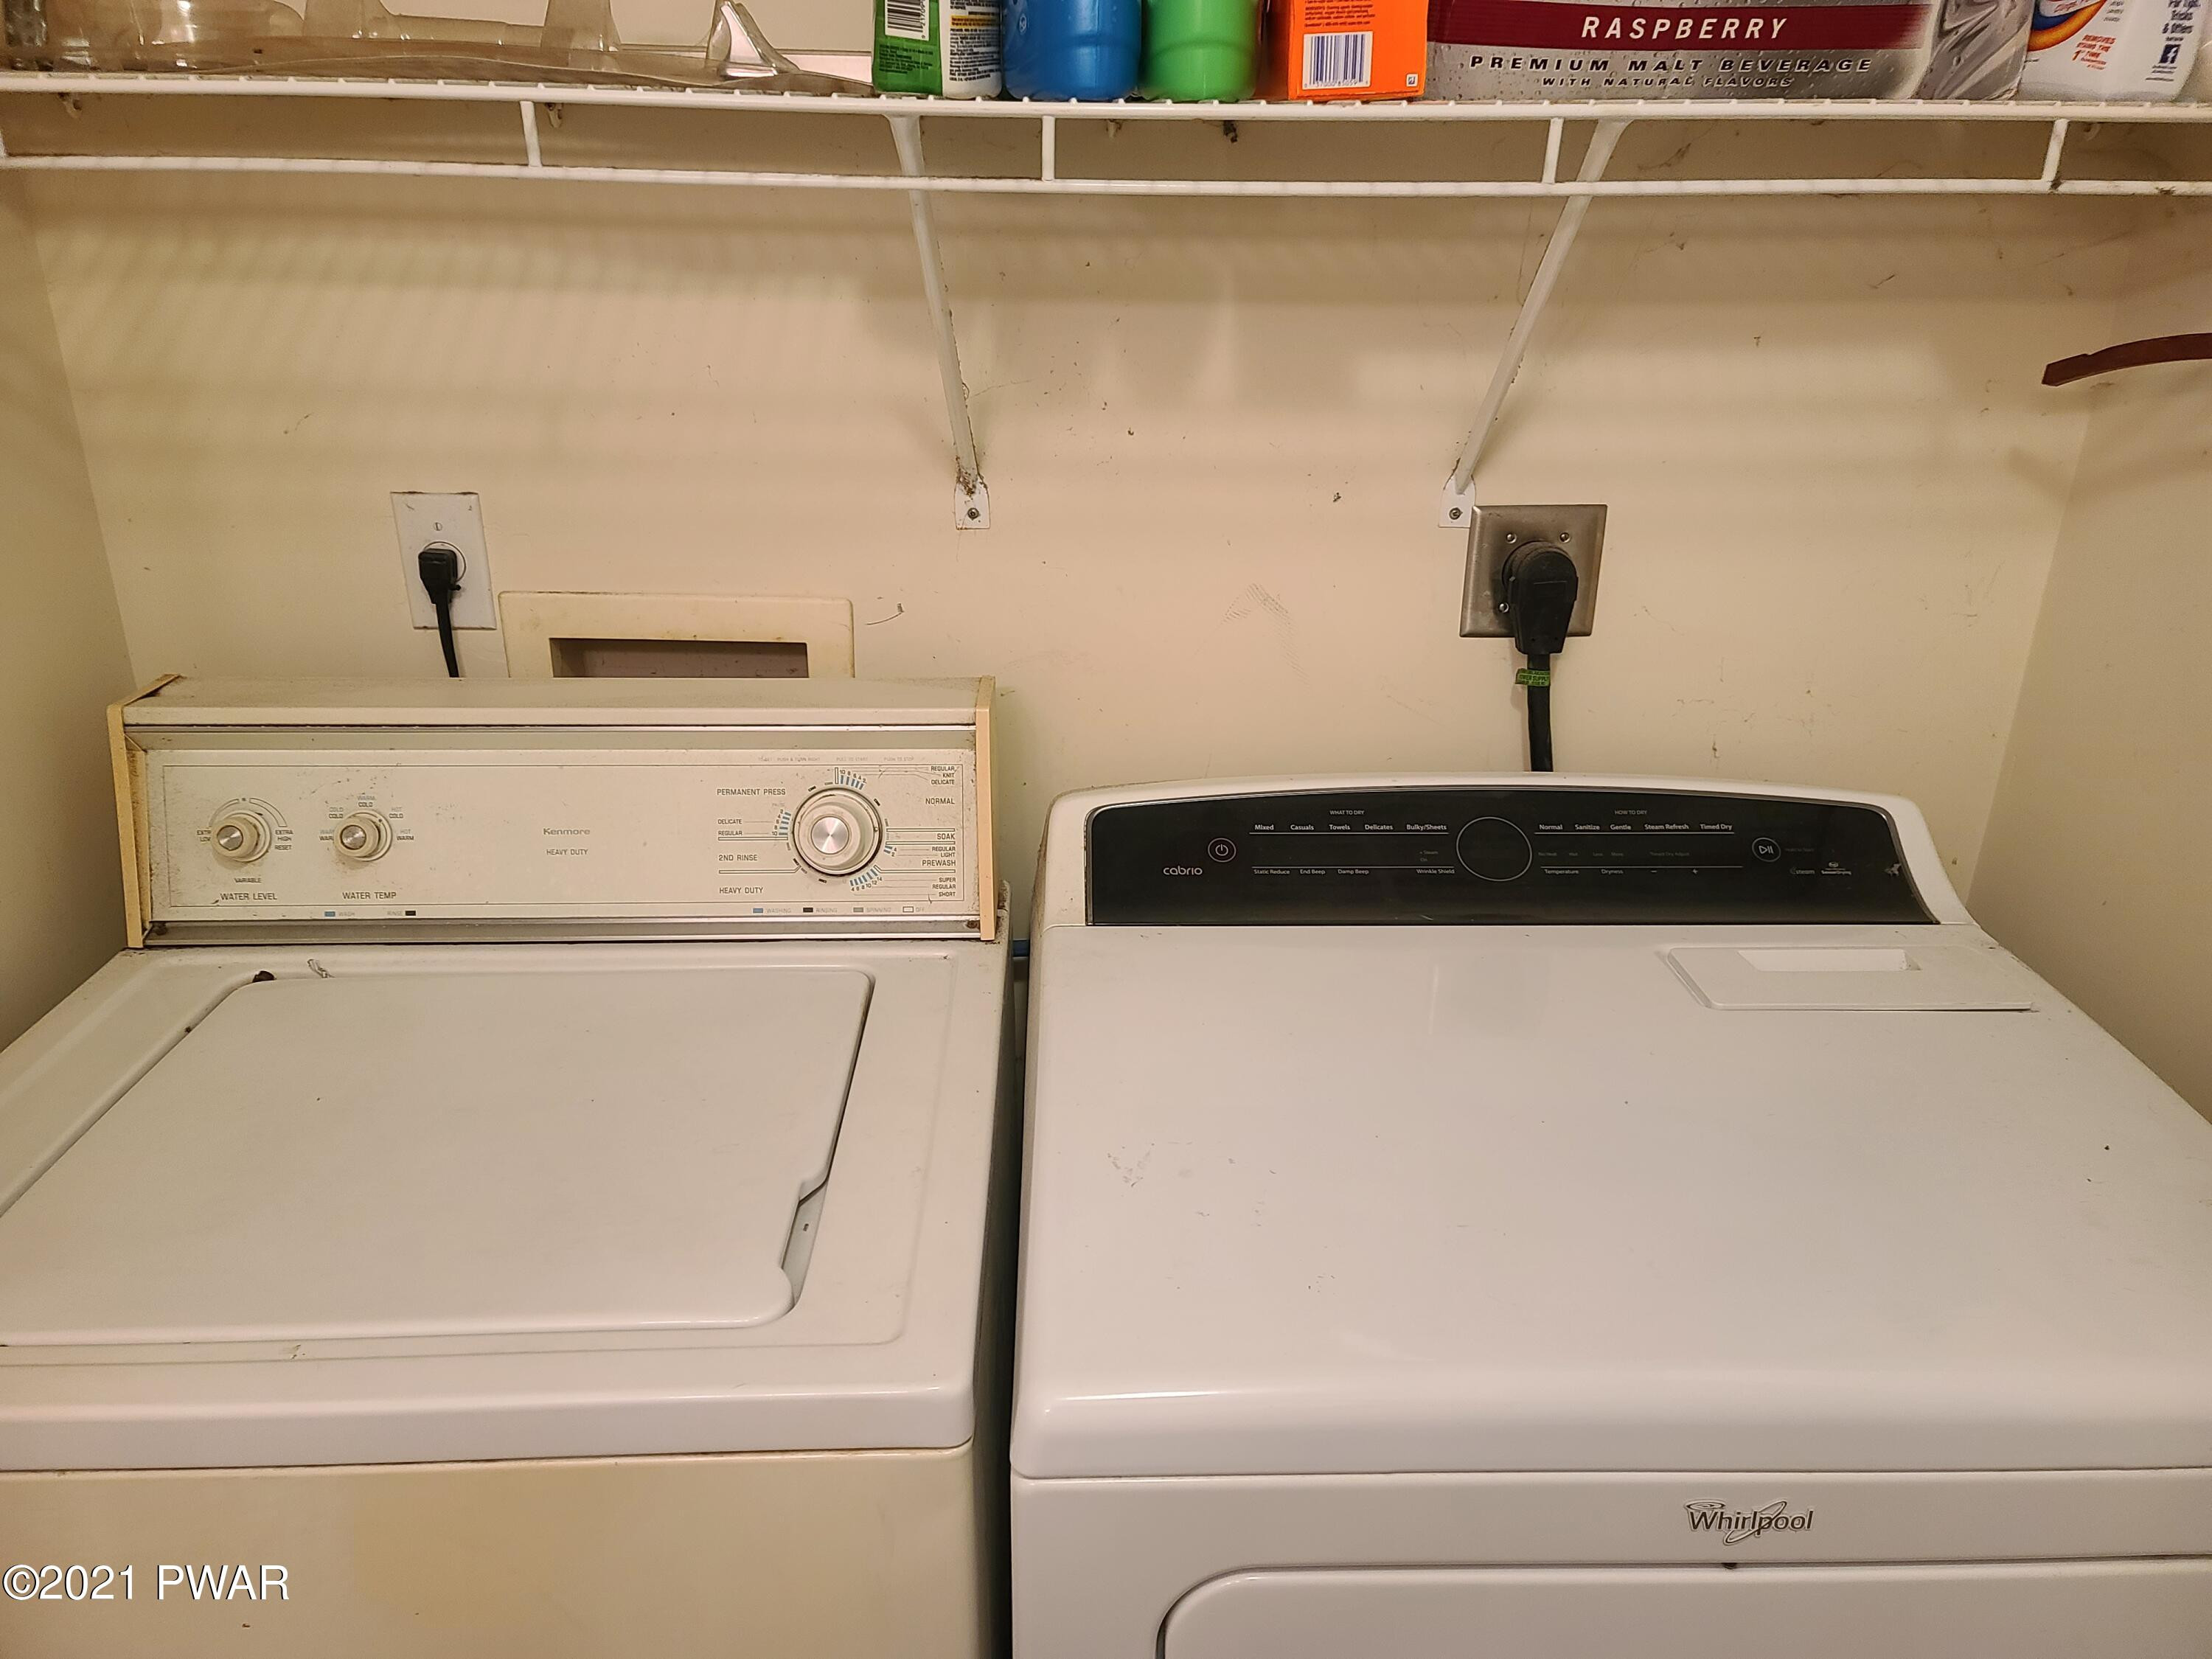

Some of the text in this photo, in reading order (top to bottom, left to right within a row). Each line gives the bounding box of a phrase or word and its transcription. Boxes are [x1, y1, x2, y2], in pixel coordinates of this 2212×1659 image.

[1582, 16, 1787, 39] RASPBERRY
[1470, 55, 1872, 72] PREMIUM MALT BEVERAGE
[1543, 77, 1793, 87] WITH NATURAL FLAVORS
[925, 797, 955, 805] NORMAL
[543, 827, 591, 835] Kenmore
[1406, 824, 1447, 832] Bulky/Sheets
[1720, 824, 1733, 832] Dry
[1163, 865, 1203, 876] cabrio
[220, 892, 249, 901] WATER
[342, 891, 397, 900] WATER TEMP
[1688, 1506, 1815, 1539] Whirlpool
